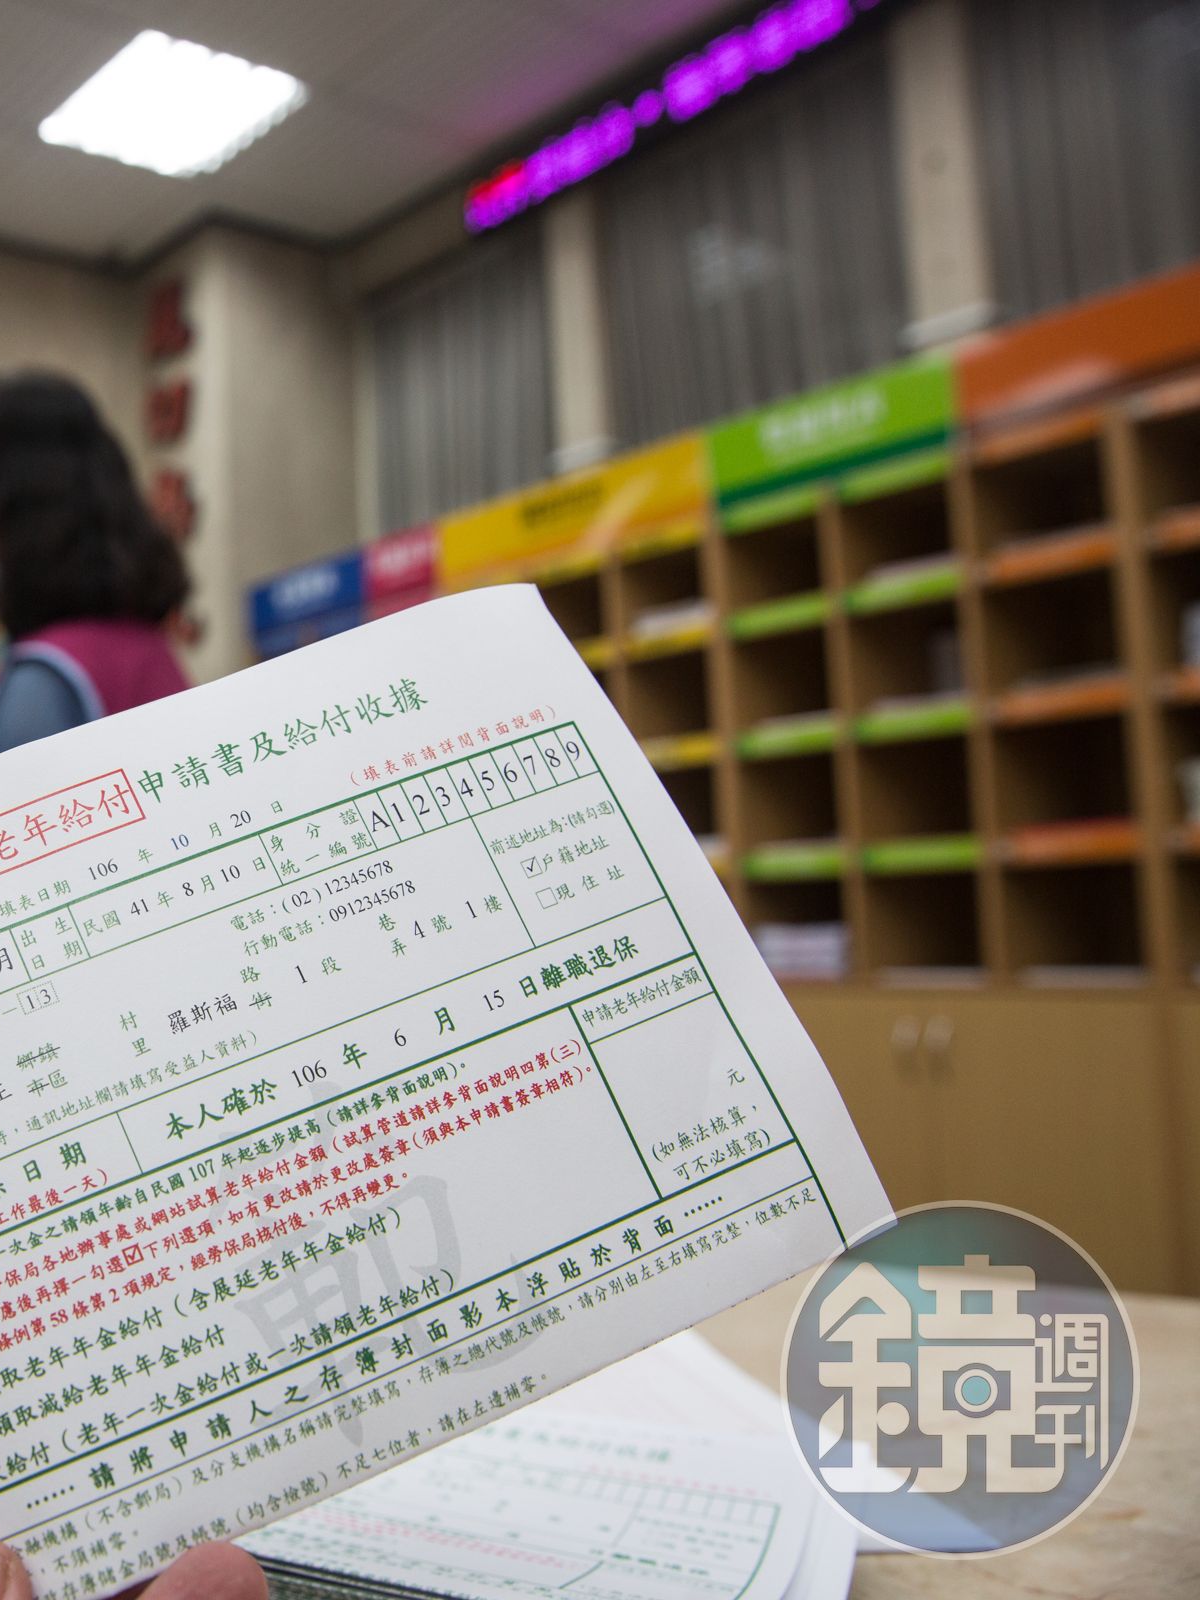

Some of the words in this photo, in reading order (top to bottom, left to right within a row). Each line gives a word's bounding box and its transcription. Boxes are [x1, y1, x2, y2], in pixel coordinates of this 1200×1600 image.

[0, 880, 72, 919] 填表日期
[88, 858, 118, 881] 106
[138, 849, 154, 865] 年
[171, 834, 189, 850] 10
[209, 822, 222, 839] 月
[230, 810, 251, 829] 20
[271, 801, 283, 815] 日
[84, 911, 122, 937] 民國
[130, 899, 150, 917] 41
[157, 891, 174, 909] 年
[182, 882, 194, 897] 8
[201, 875, 215, 893] 月
[220, 865, 240, 883] 10
[254, 857, 267, 872] 日
[120, 1011, 138, 1032] 村
[132, 1037, 151, 1057] 里
[168, 994, 238, 1035] 羅斯福
[322, 956, 342, 975] 段
[379, 912, 396, 932] 巷
[413, 920, 425, 939] 4
[431, 914, 452, 934] 號
[166, 1078, 278, 1140] 本人確於
[291, 1060, 327, 1087] 106
[342, 1043, 368, 1070] 年
[394, 1028, 407, 1047] 6
[434, 1007, 455, 1034] 月
[482, 989, 505, 1013] 15
[726, 1067, 745, 1086] 元
